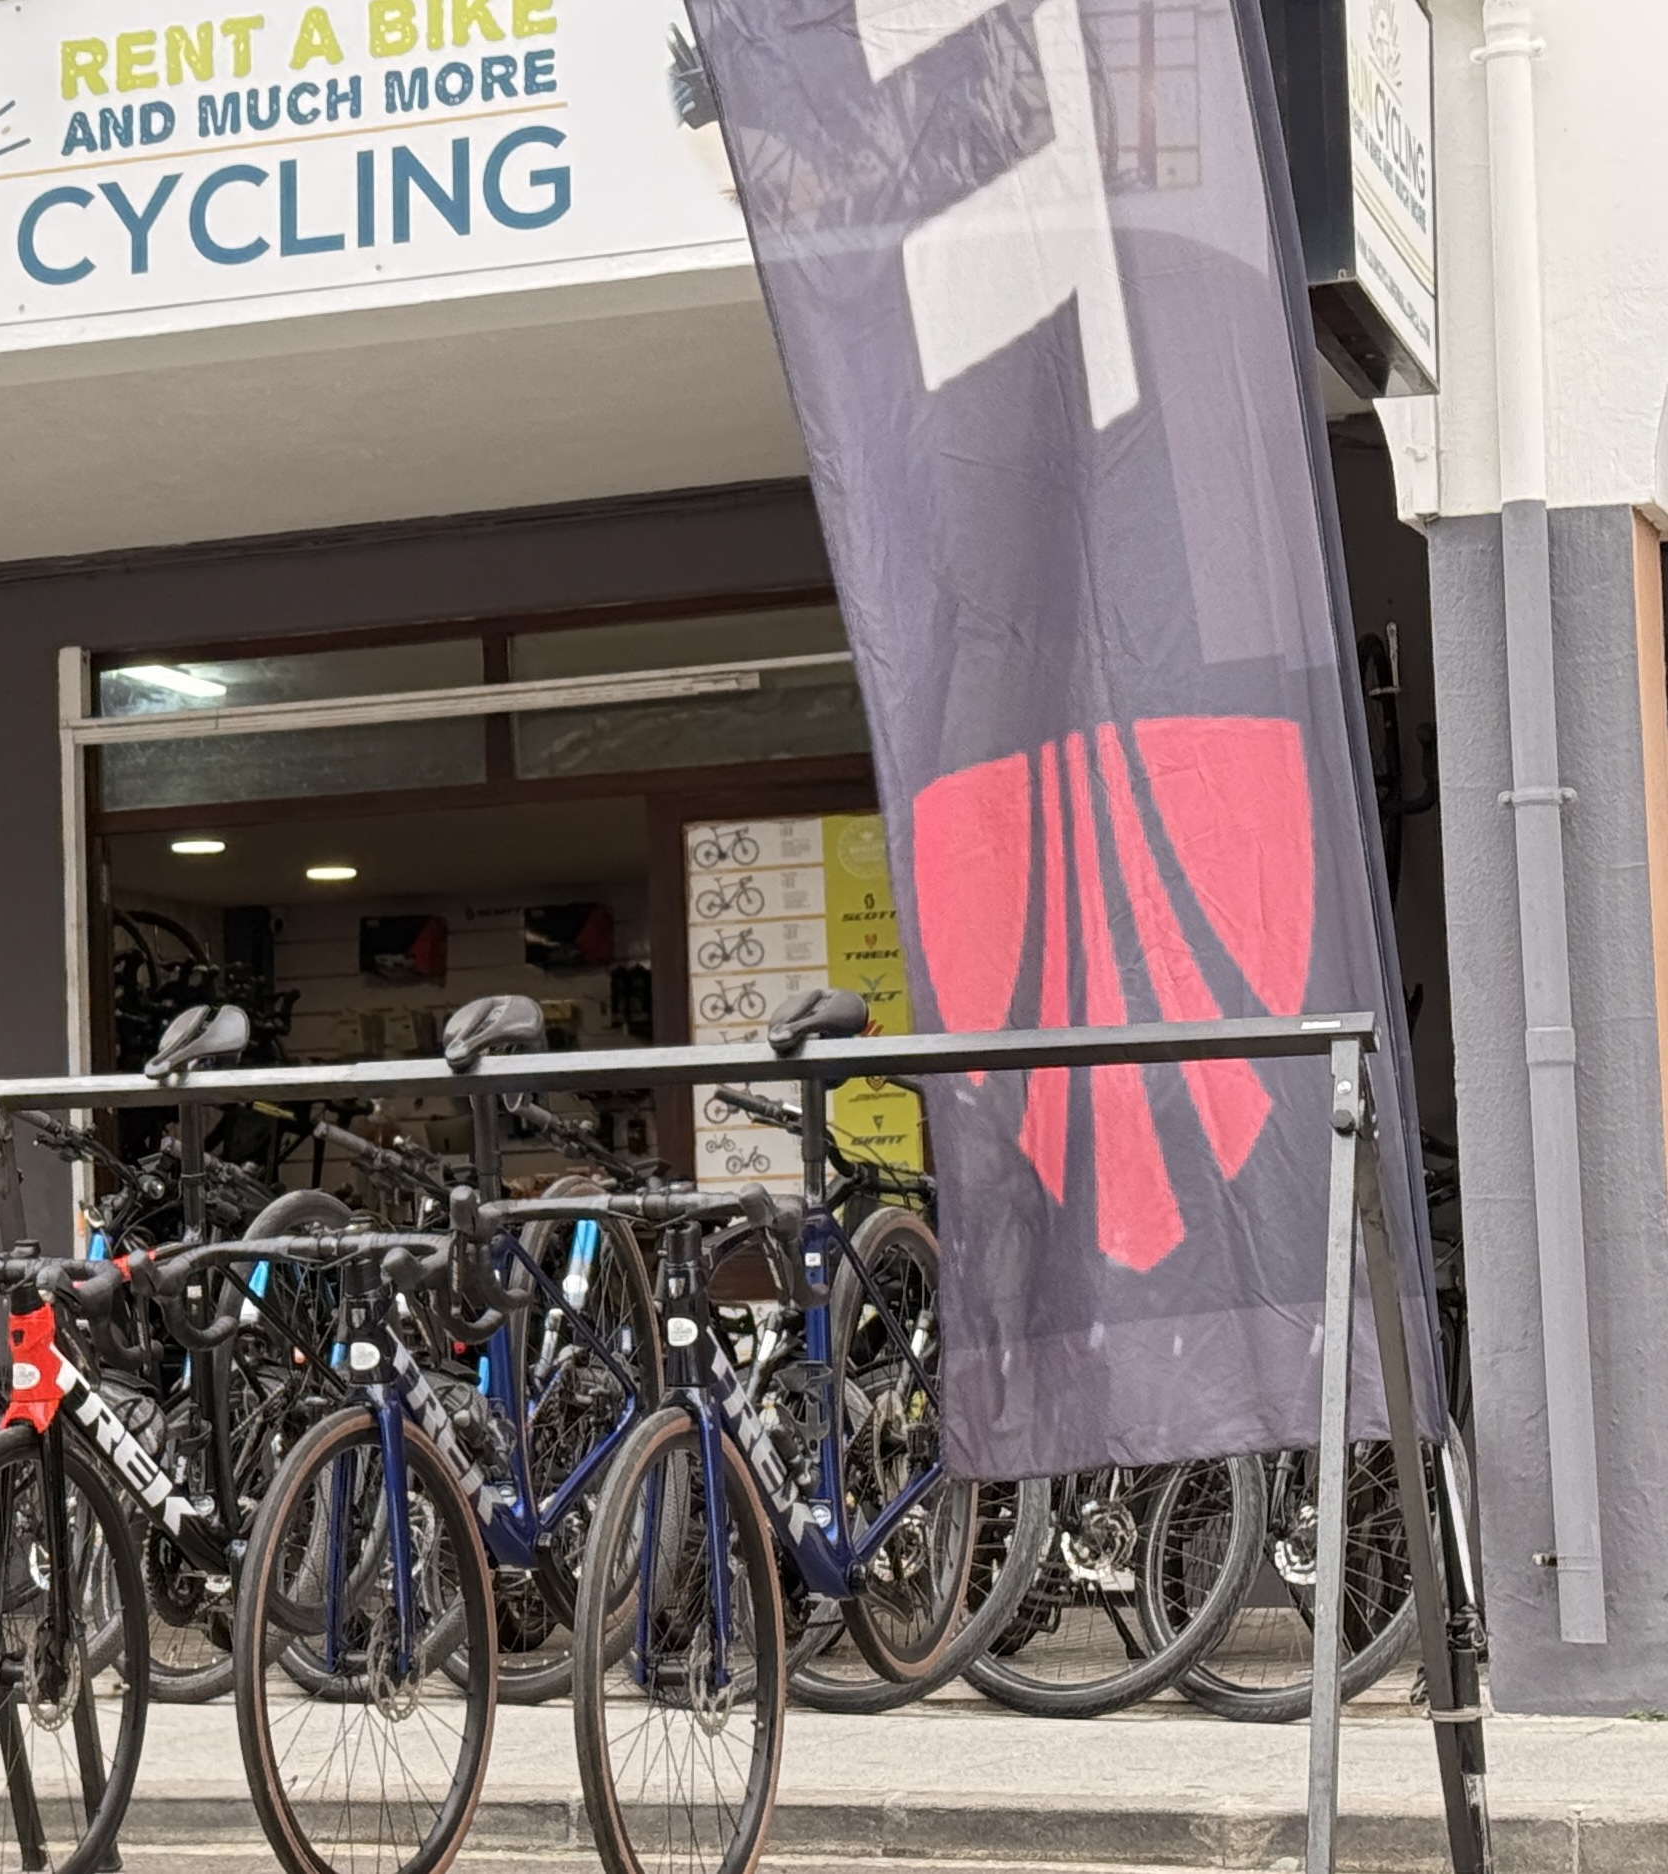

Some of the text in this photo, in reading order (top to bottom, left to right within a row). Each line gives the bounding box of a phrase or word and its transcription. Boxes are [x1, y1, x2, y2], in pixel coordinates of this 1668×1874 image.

[60, 0, 558, 101] RENT A BIKE
[61, 48, 558, 157] AND MUCH MORE
[1374, 81, 1426, 201] CYCLING
[16, 124, 572, 286] CYCLING
[841, 909, 897, 922] SCOTT
[843, 949, 900, 962] TREK
[858, 989, 902, 1004] ELT
[850, 1134, 909, 1147] GIANT
[49, 1343, 199, 1537] TREK
[386, 1325, 507, 1527] TREK
[706, 1325, 818, 1547] TREK
